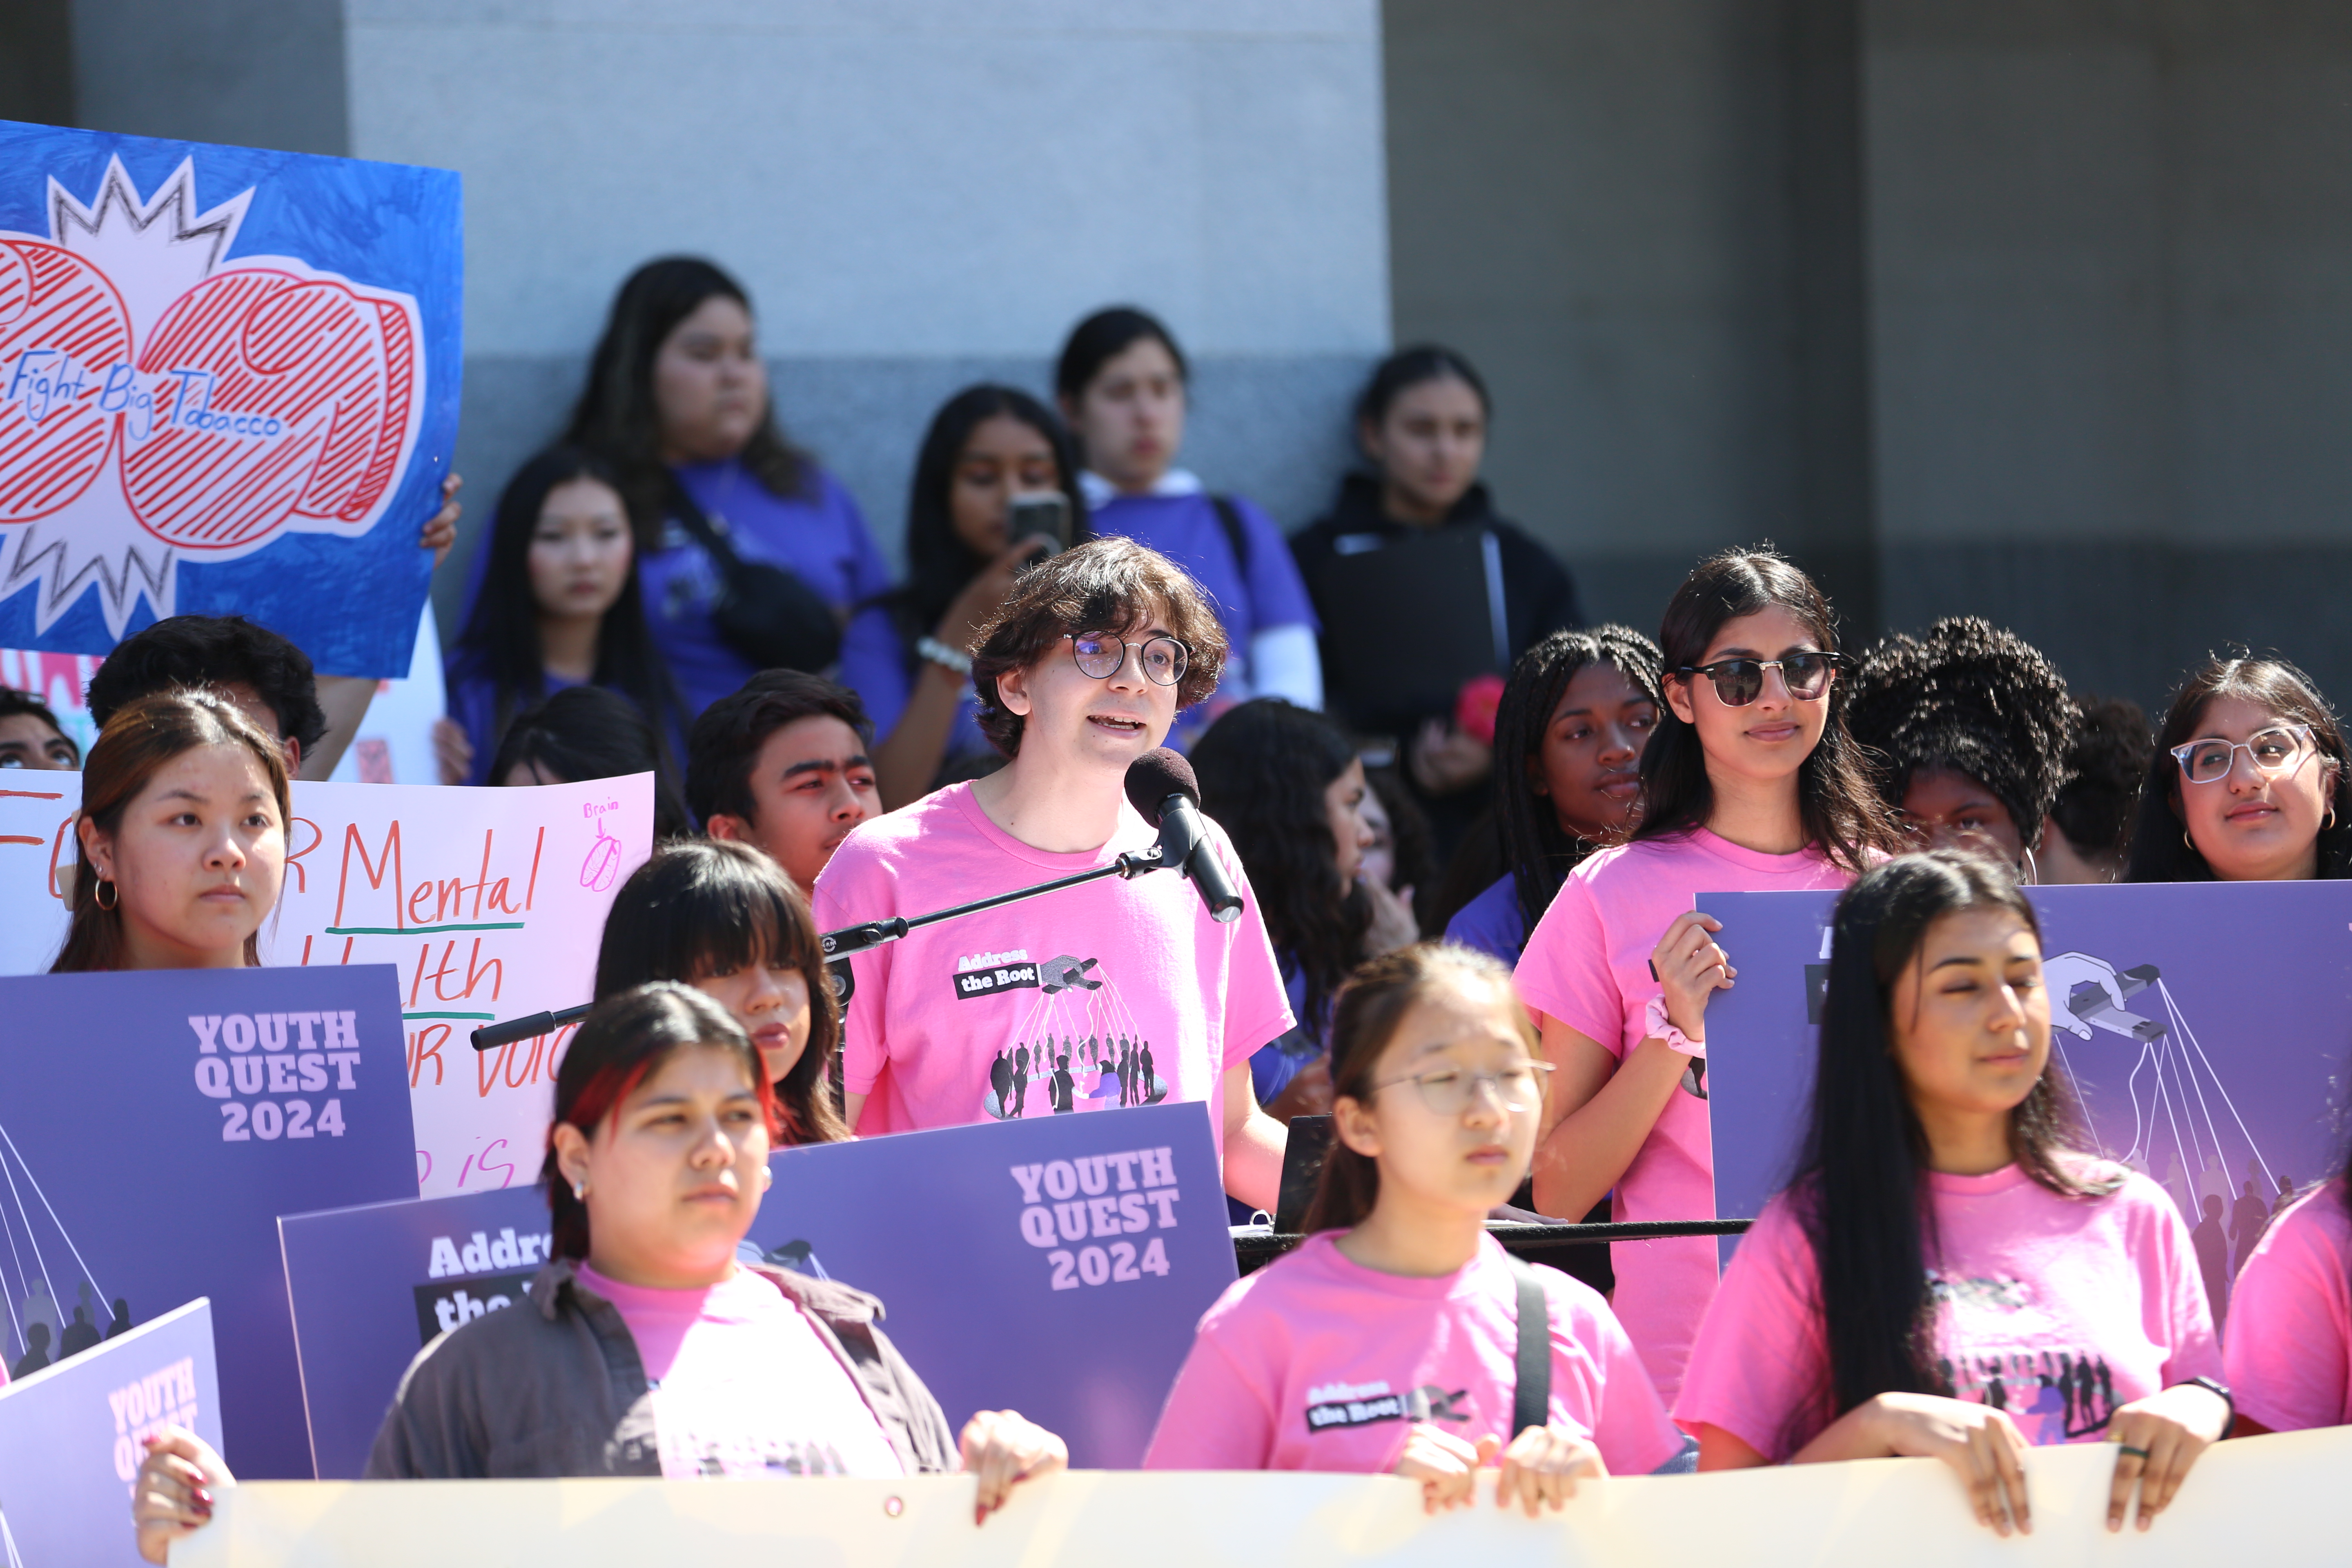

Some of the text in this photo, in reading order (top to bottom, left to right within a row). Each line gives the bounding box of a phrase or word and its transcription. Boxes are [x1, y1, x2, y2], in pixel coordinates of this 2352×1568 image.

[8, 350, 281, 441] Fight Big Tobacco
[583, 796, 619, 819] Brain
[334, 820, 545, 932] Mental
[958, 949, 1028, 972] Address
[961, 967, 1035, 992] the Root
[188, 1010, 359, 1054] YOUTH
[194, 1051, 361, 1098] QUEST
[220, 1098, 346, 1142] 2024
[1010, 1146, 1178, 1204] YOUTH
[1020, 1187, 1180, 1248] QUEST
[1047, 1237, 1171, 1291] 2024
[108, 1355, 198, 1435] YOUTH
